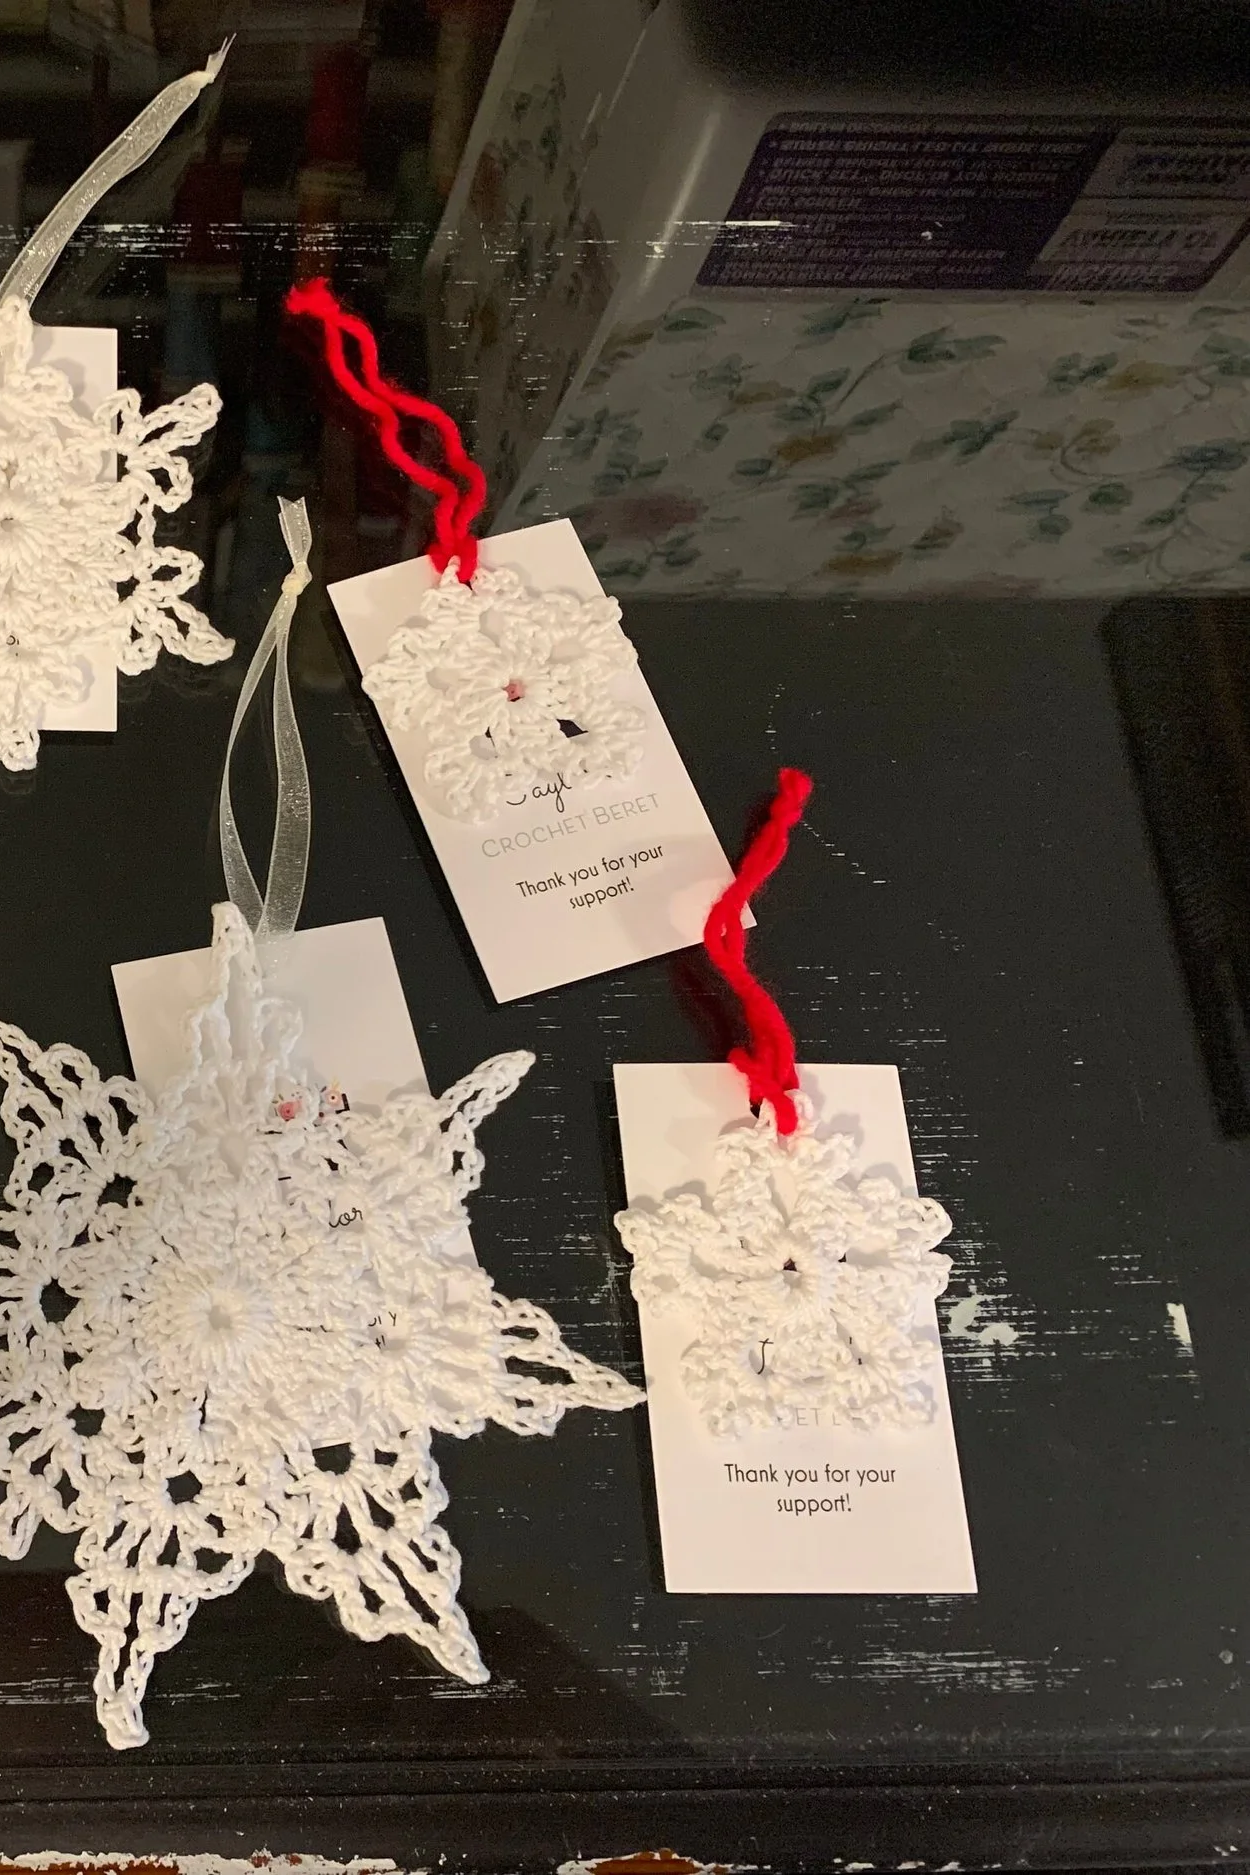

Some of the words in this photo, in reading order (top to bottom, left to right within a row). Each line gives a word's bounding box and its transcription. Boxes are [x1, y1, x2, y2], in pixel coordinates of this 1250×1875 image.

[481, 813, 589, 859] CROCHET
[592, 792, 661, 826] BERET
[515, 872, 567, 898] Thank
[568, 864, 600, 887] you
[601, 856, 626, 873] for
[628, 844, 664, 869] your
[568, 876, 636, 910] support!
[724, 1463, 779, 1483] Thank
[784, 1468, 819, 1488] you
[824, 1463, 851, 1483] for
[856, 1468, 897, 1487] your
[777, 1493, 852, 1517] support!
